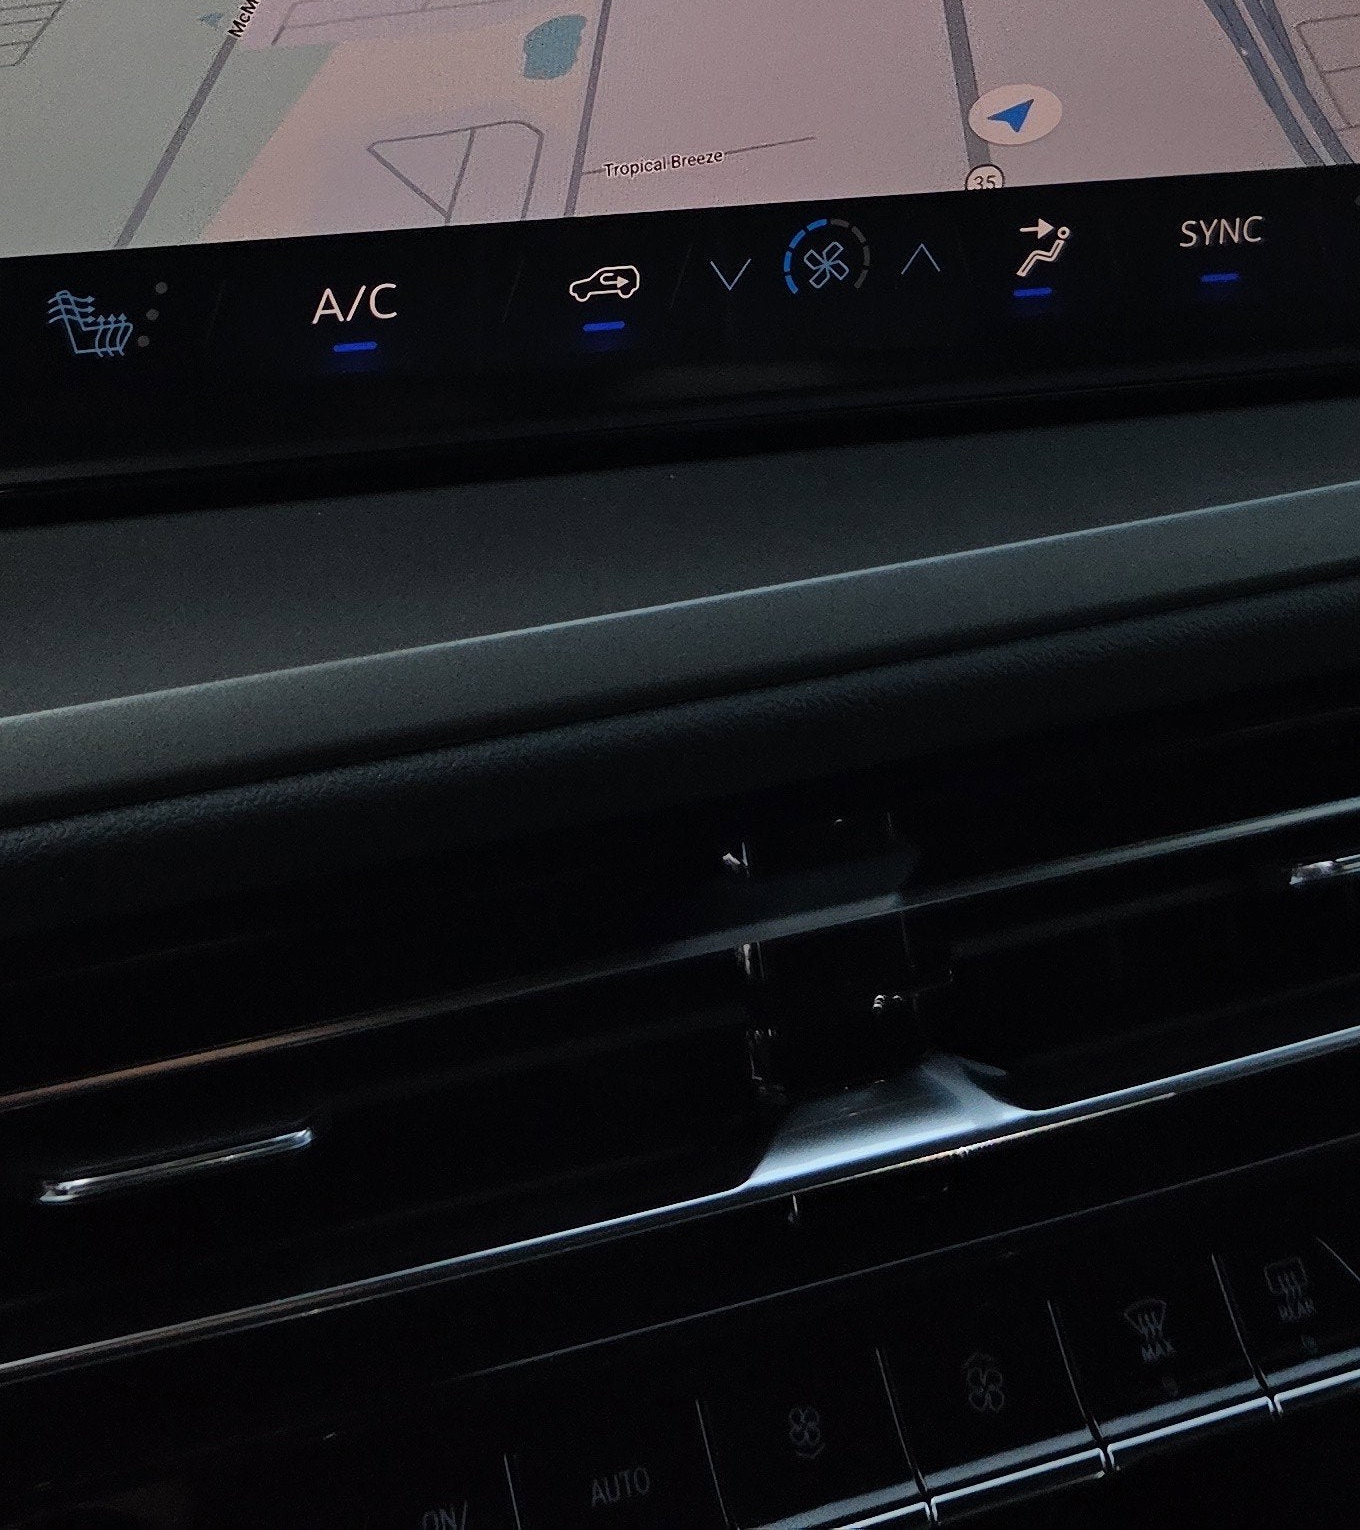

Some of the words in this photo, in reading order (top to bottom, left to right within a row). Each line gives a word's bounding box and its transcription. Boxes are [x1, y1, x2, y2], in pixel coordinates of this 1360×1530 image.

[602, 155, 667, 178] Tropical
[670, 150, 724, 169] Breeze
[1178, 215, 1264, 248] SYNC
[311, 282, 398, 325] A/C
[590, 1465, 652, 1508] AUTO
